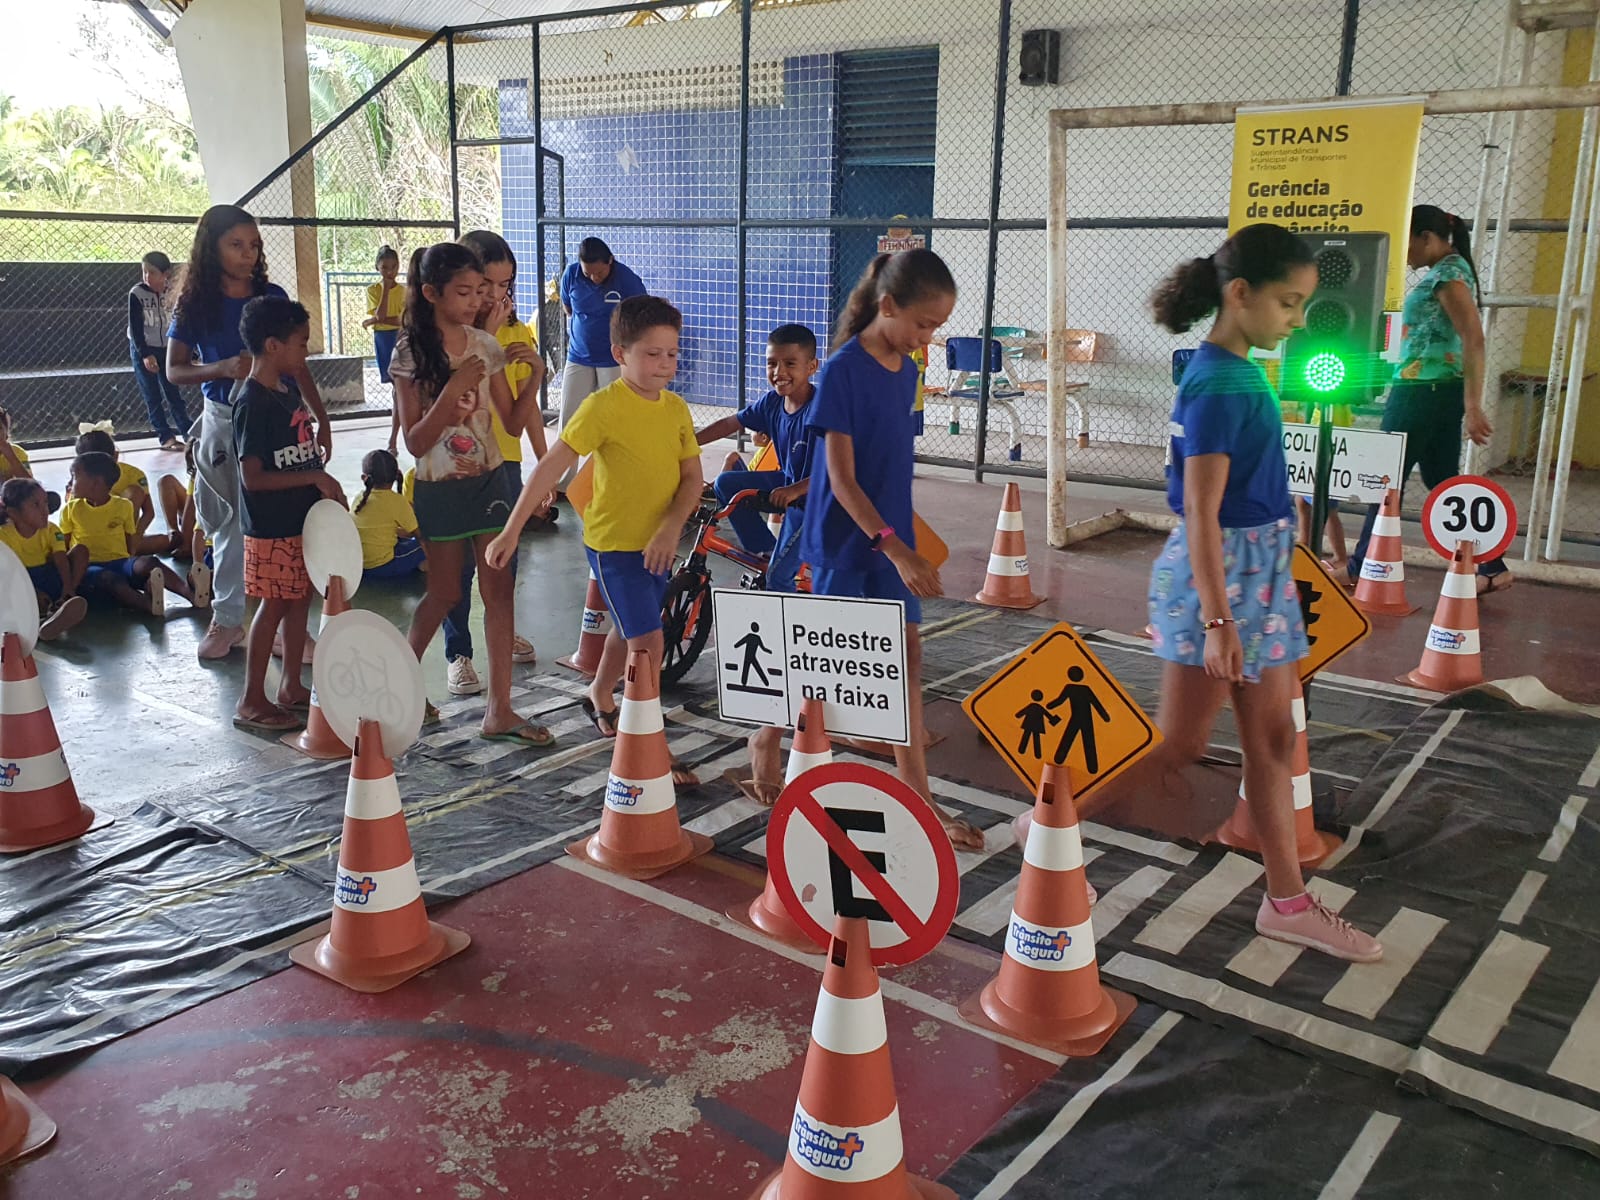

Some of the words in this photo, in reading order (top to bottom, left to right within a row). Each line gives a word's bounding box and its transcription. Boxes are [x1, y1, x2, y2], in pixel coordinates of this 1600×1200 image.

[1252, 125, 1349, 146] STRANS
[1301, 153, 1347, 162] Transportes
[1248, 179, 1330, 197] Gerência
[1246, 202, 1268, 218] de
[1272, 200, 1363, 220] educação
[1442, 496, 1496, 532] 30
[792, 624, 892, 652] Pedestre
[790, 652, 899, 680] atravesse
[802, 684, 827, 701] na
[835, 683, 889, 710] faixa
[824, 807, 894, 922] E
[1013, 924, 1052, 946] Trânsito
[1018, 940, 1062, 960] Seguro
[798, 1138, 850, 1168] Seguro
